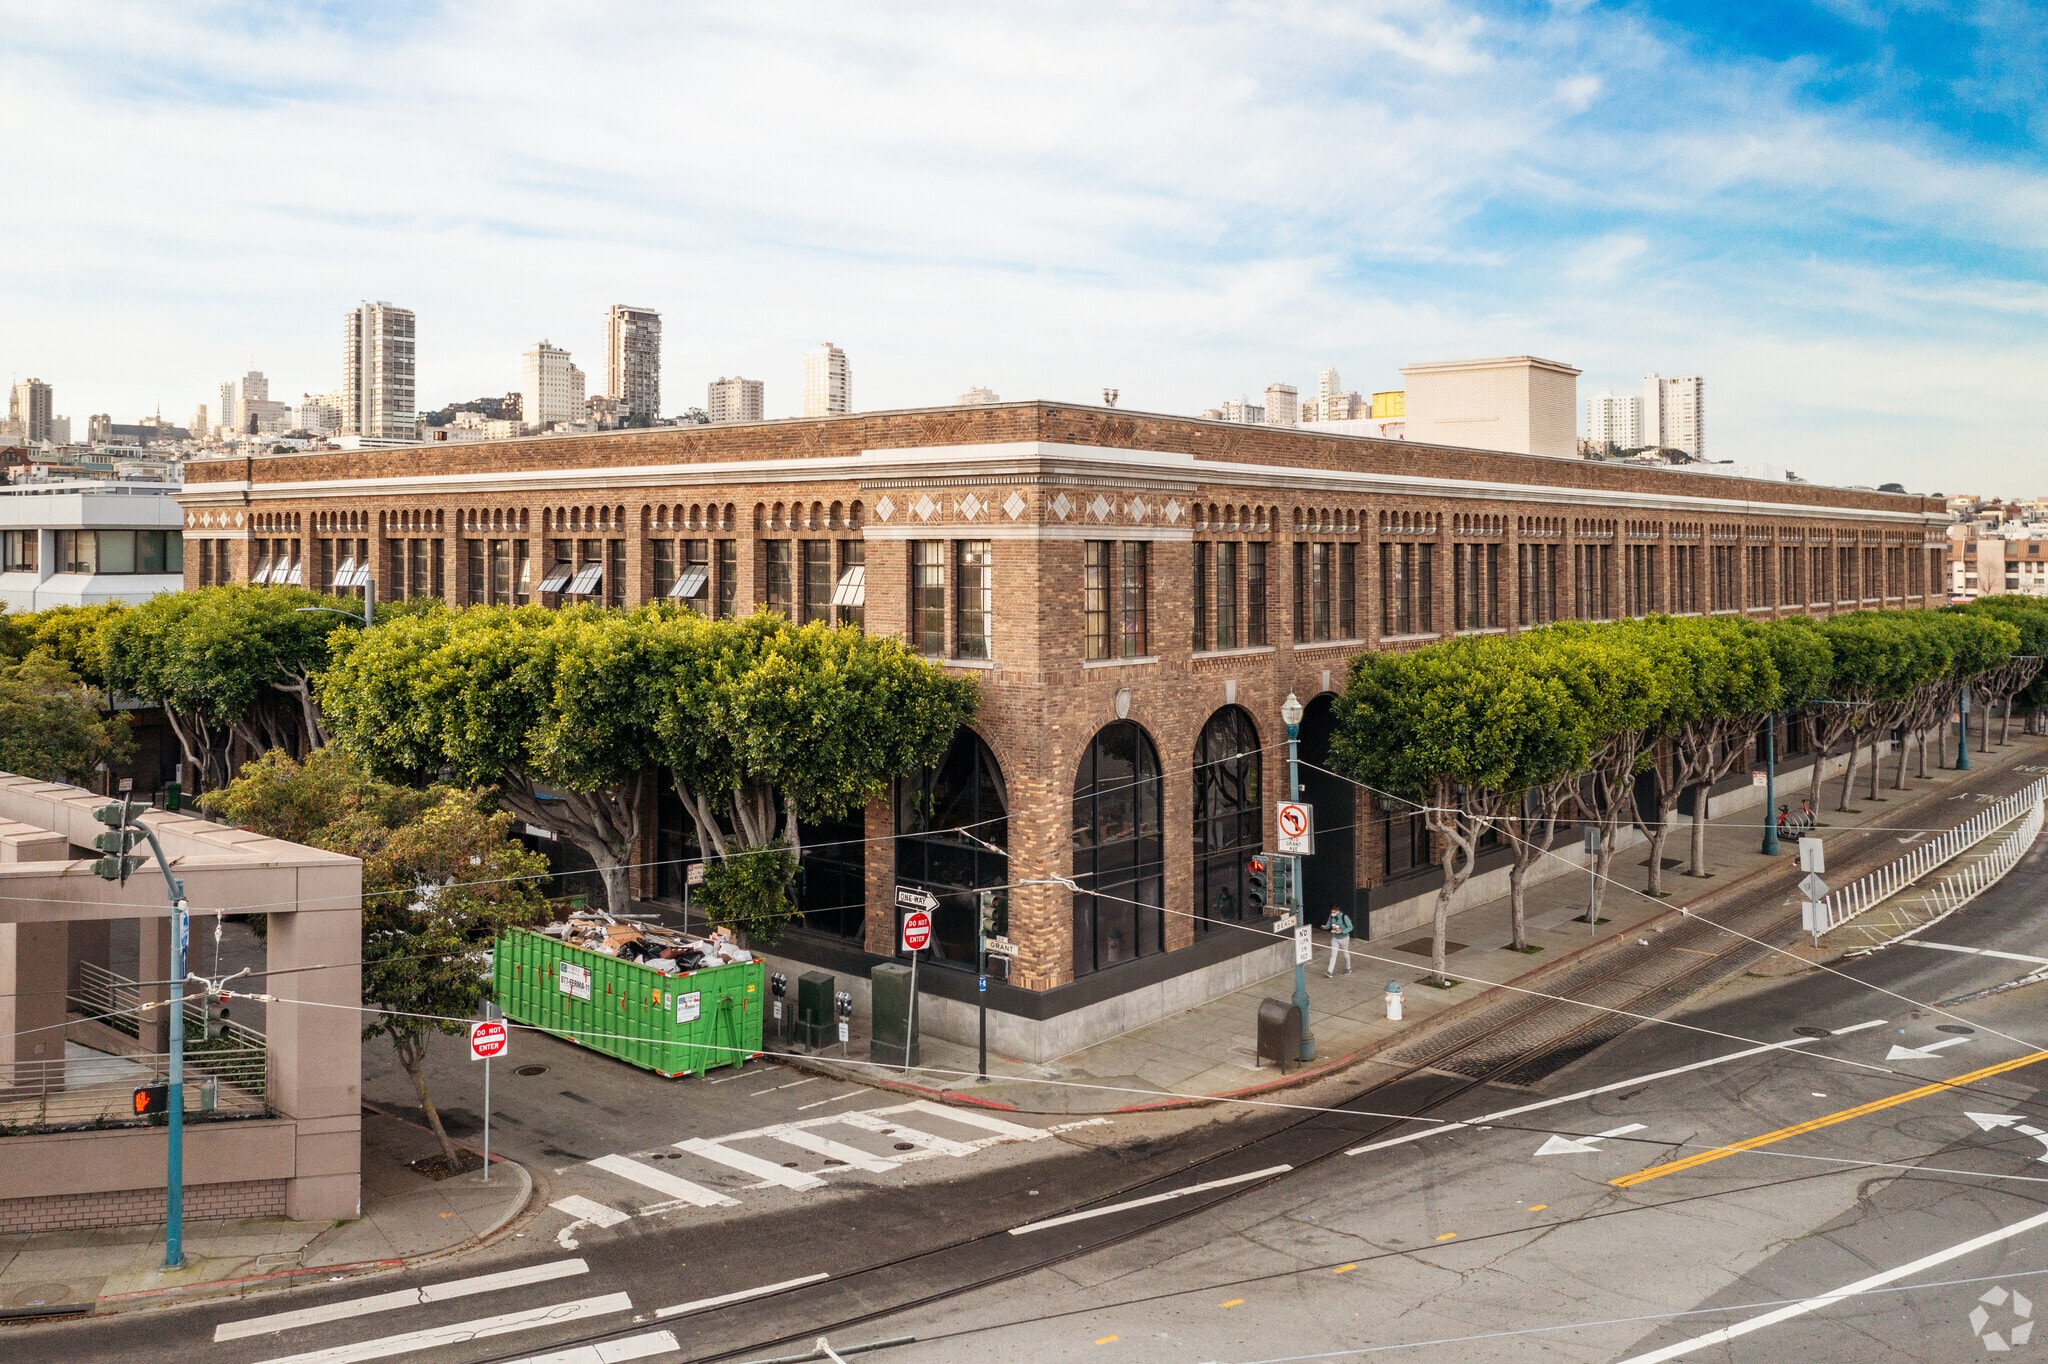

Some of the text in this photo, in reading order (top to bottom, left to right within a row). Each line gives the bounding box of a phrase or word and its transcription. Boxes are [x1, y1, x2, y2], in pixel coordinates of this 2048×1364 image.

[901, 893, 925, 904] ONE WAY
[1276, 919, 1295, 930] BEACH
[1300, 929, 1308, 937] NO
[990, 941, 1013, 952] GRANT
[476, 1026, 501, 1037] DO NOT
[479, 1042, 499, 1052] ENTER
